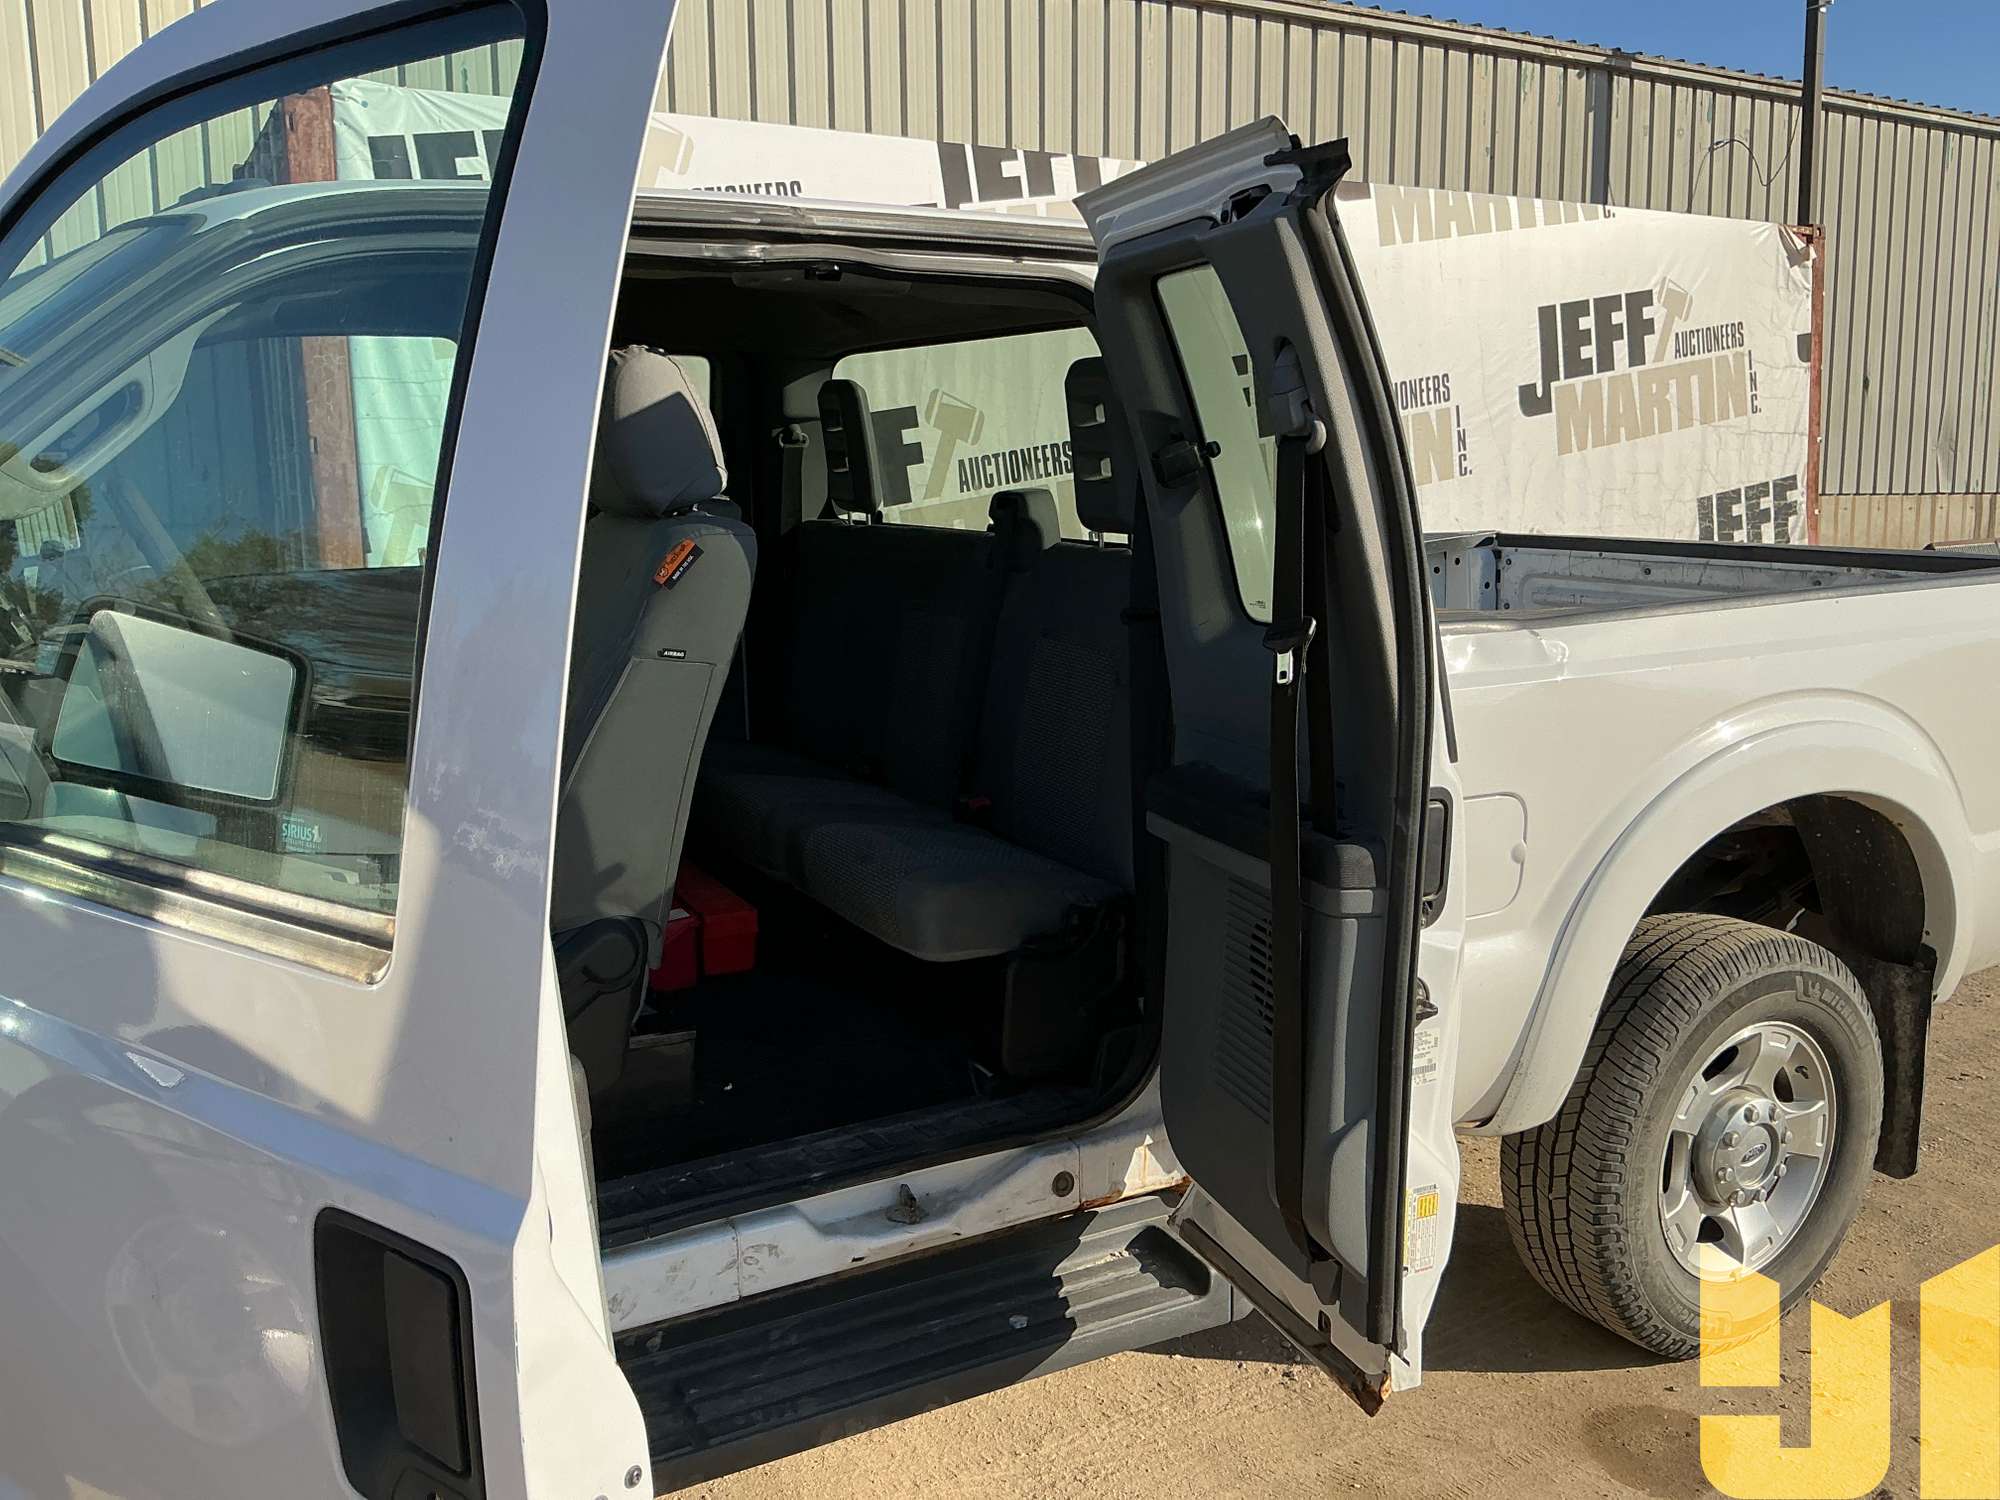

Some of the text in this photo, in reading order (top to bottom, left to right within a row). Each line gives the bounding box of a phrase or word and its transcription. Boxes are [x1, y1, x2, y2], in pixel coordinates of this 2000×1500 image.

[1518, 289, 1655, 417] JEFF
[1674, 321, 1745, 359] AUCTIONEERS
[1393, 373, 1451, 411] IONEERS
[1554, 351, 1748, 456] MARTIN
[1748, 350, 1762, 414] INC.
[957, 440, 1073, 493] AUCTIONEERS
[1455, 404, 1473, 477] INC.
[281, 823, 313, 841] SIRIUS
